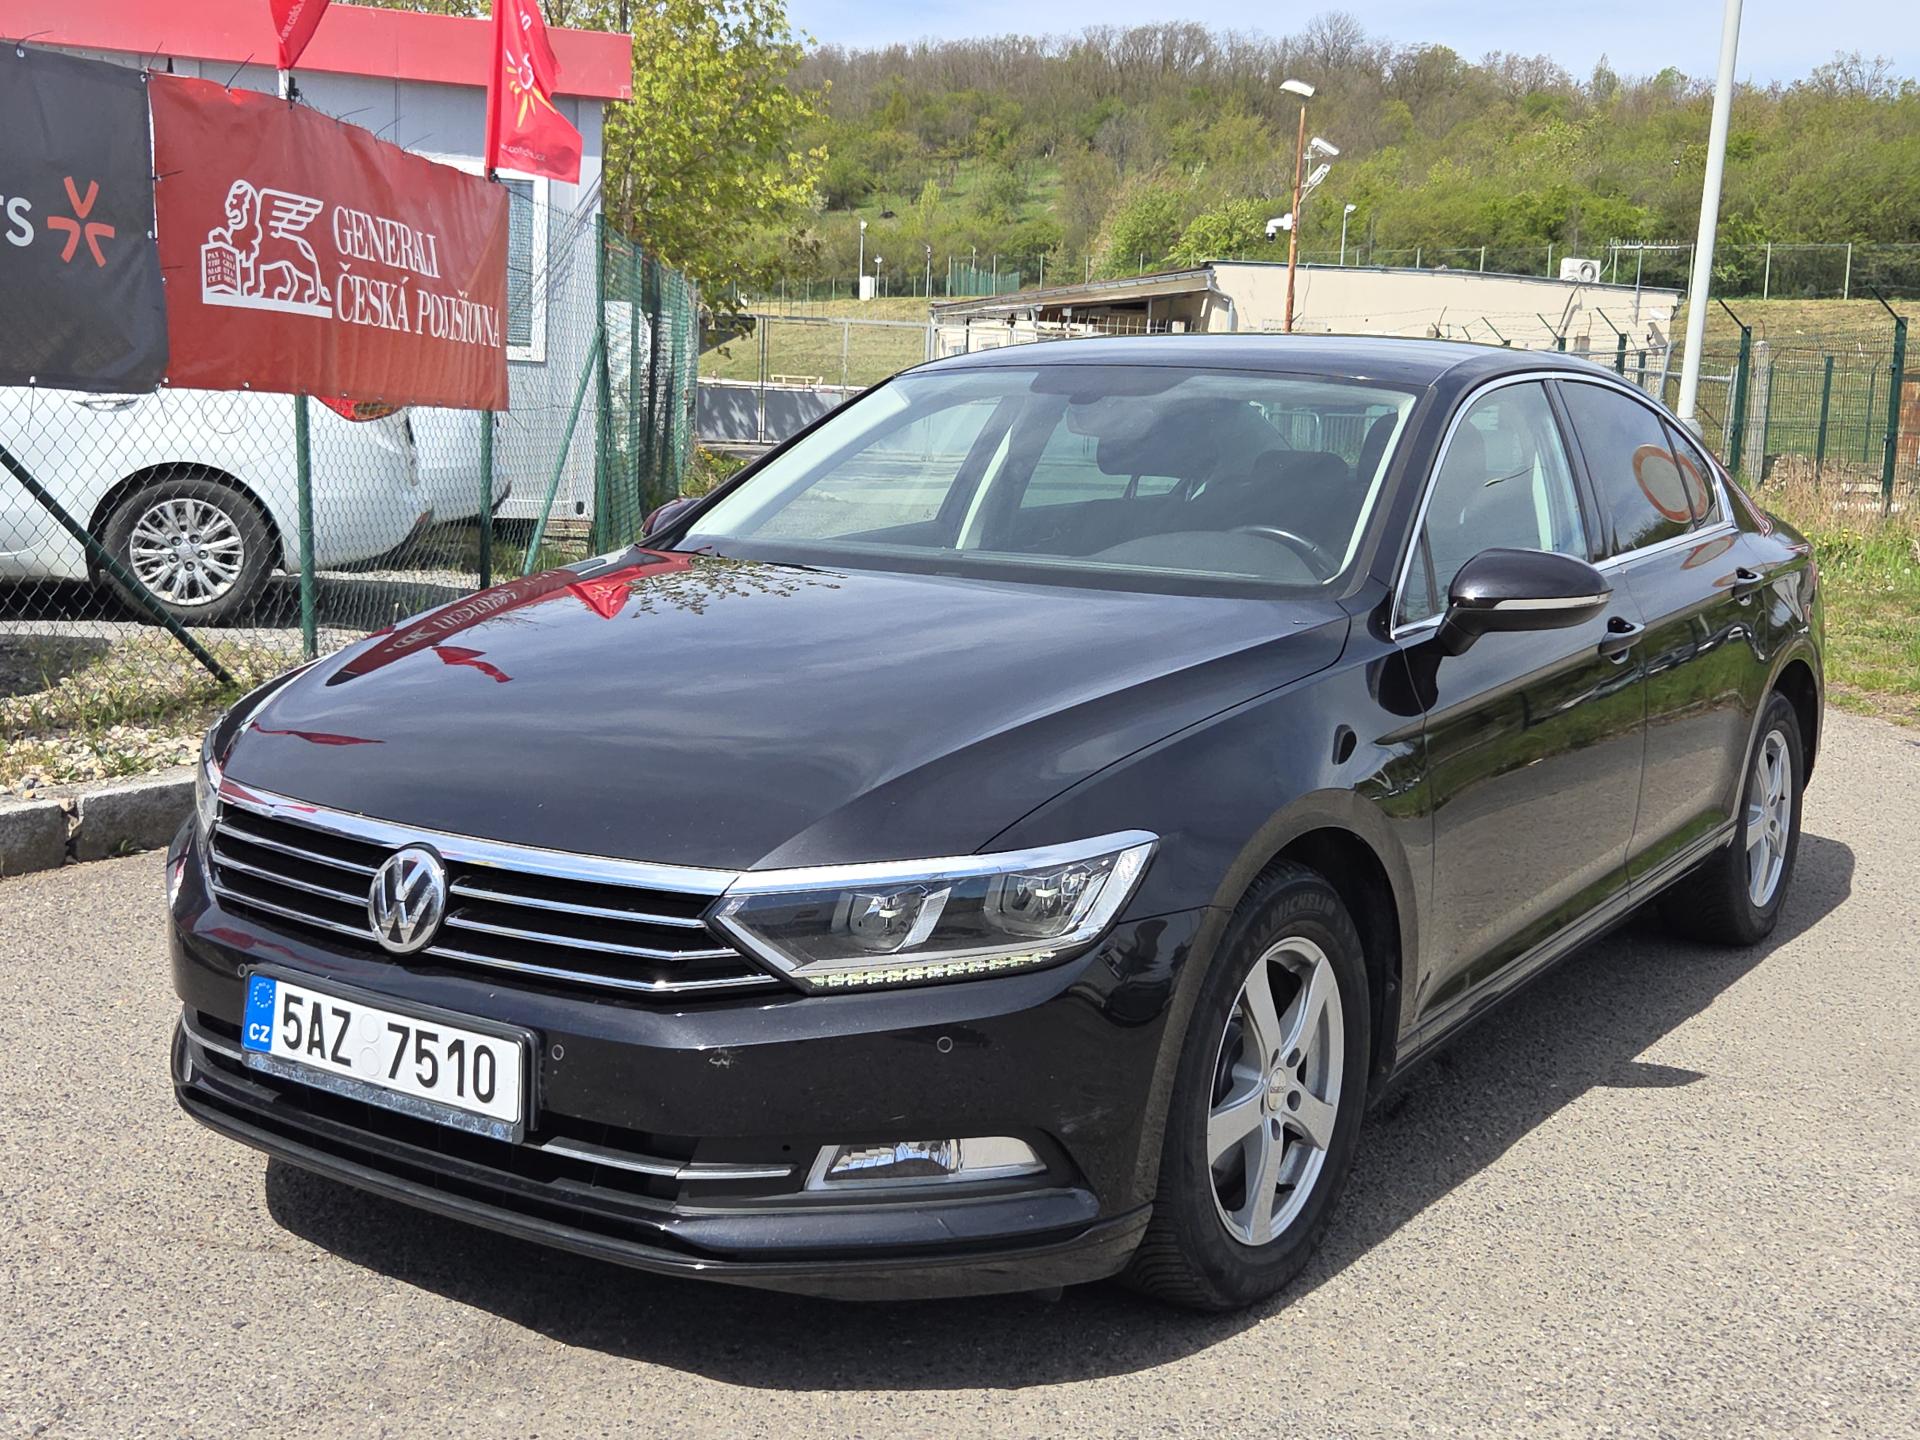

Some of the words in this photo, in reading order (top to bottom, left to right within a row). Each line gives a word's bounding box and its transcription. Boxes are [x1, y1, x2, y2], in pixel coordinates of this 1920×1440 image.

[0, 195, 35, 247] S
[333, 205, 440, 278] GENERALI
[337, 261, 411, 333] ČESKÁ
[415, 288, 501, 348] POJIŠŤOVNA
[249, 1022, 270, 1043] CZ
[283, 992, 352, 1067] 5AZ
[387, 1022, 496, 1103] 7510
